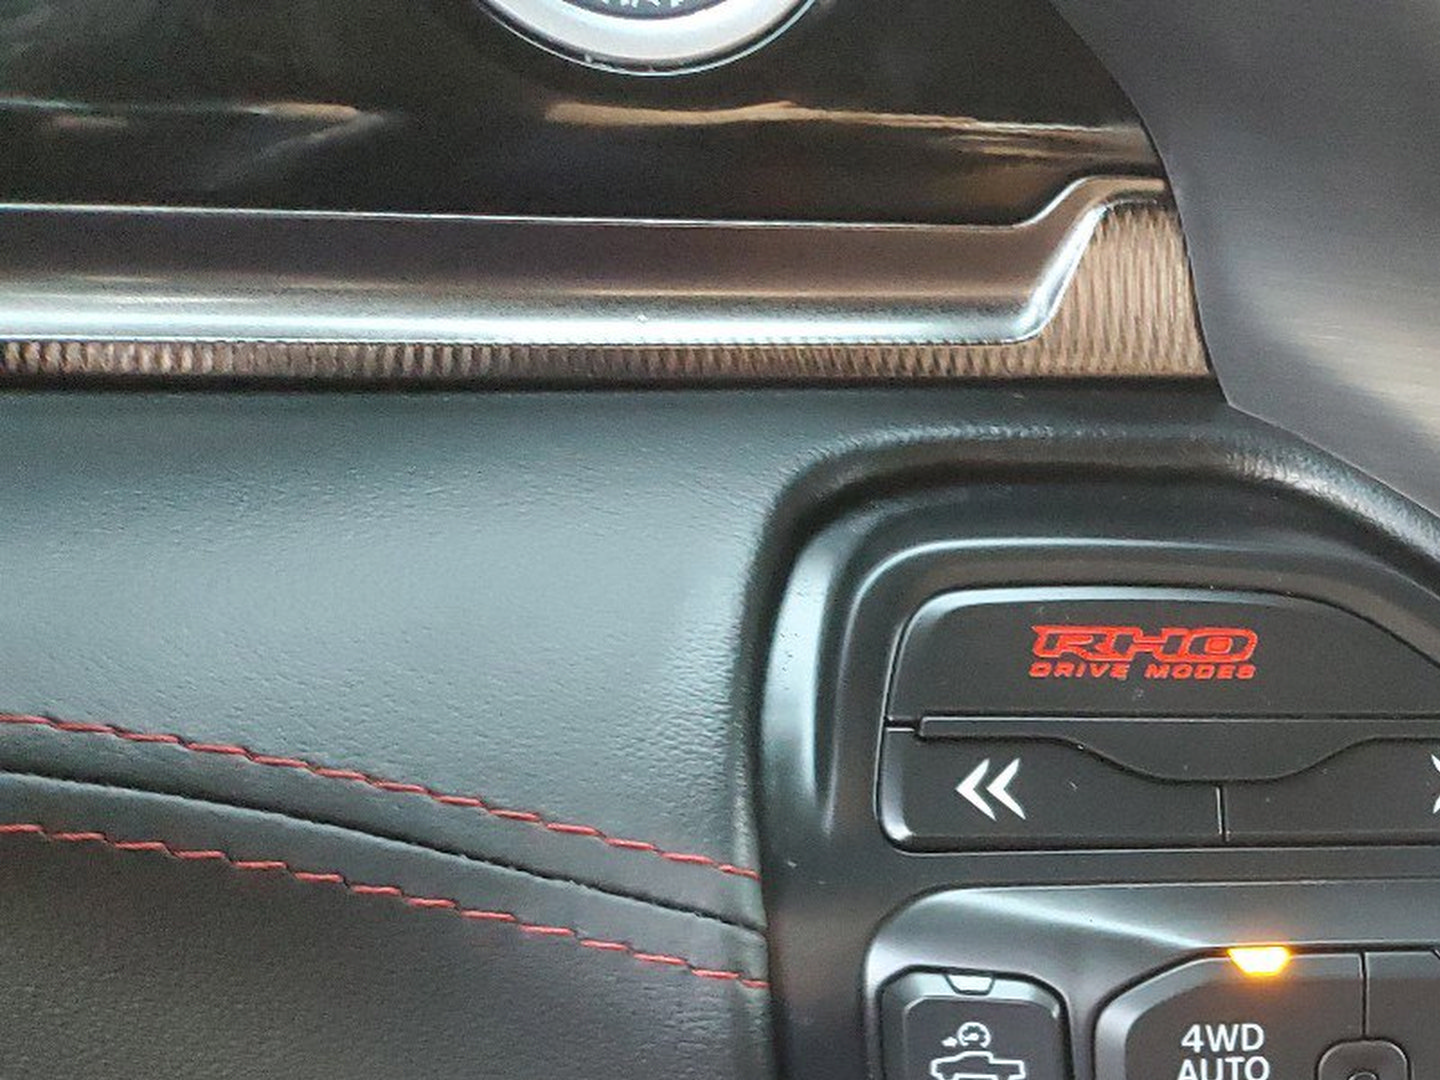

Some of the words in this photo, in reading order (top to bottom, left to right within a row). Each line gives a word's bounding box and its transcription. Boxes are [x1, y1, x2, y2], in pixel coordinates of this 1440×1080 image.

[1032, 625, 1258, 662] RHO
[1029, 662, 1130, 679] DRIVE
[1144, 664, 1257, 680] MODES
[1181, 1023, 1265, 1053] 4WD
